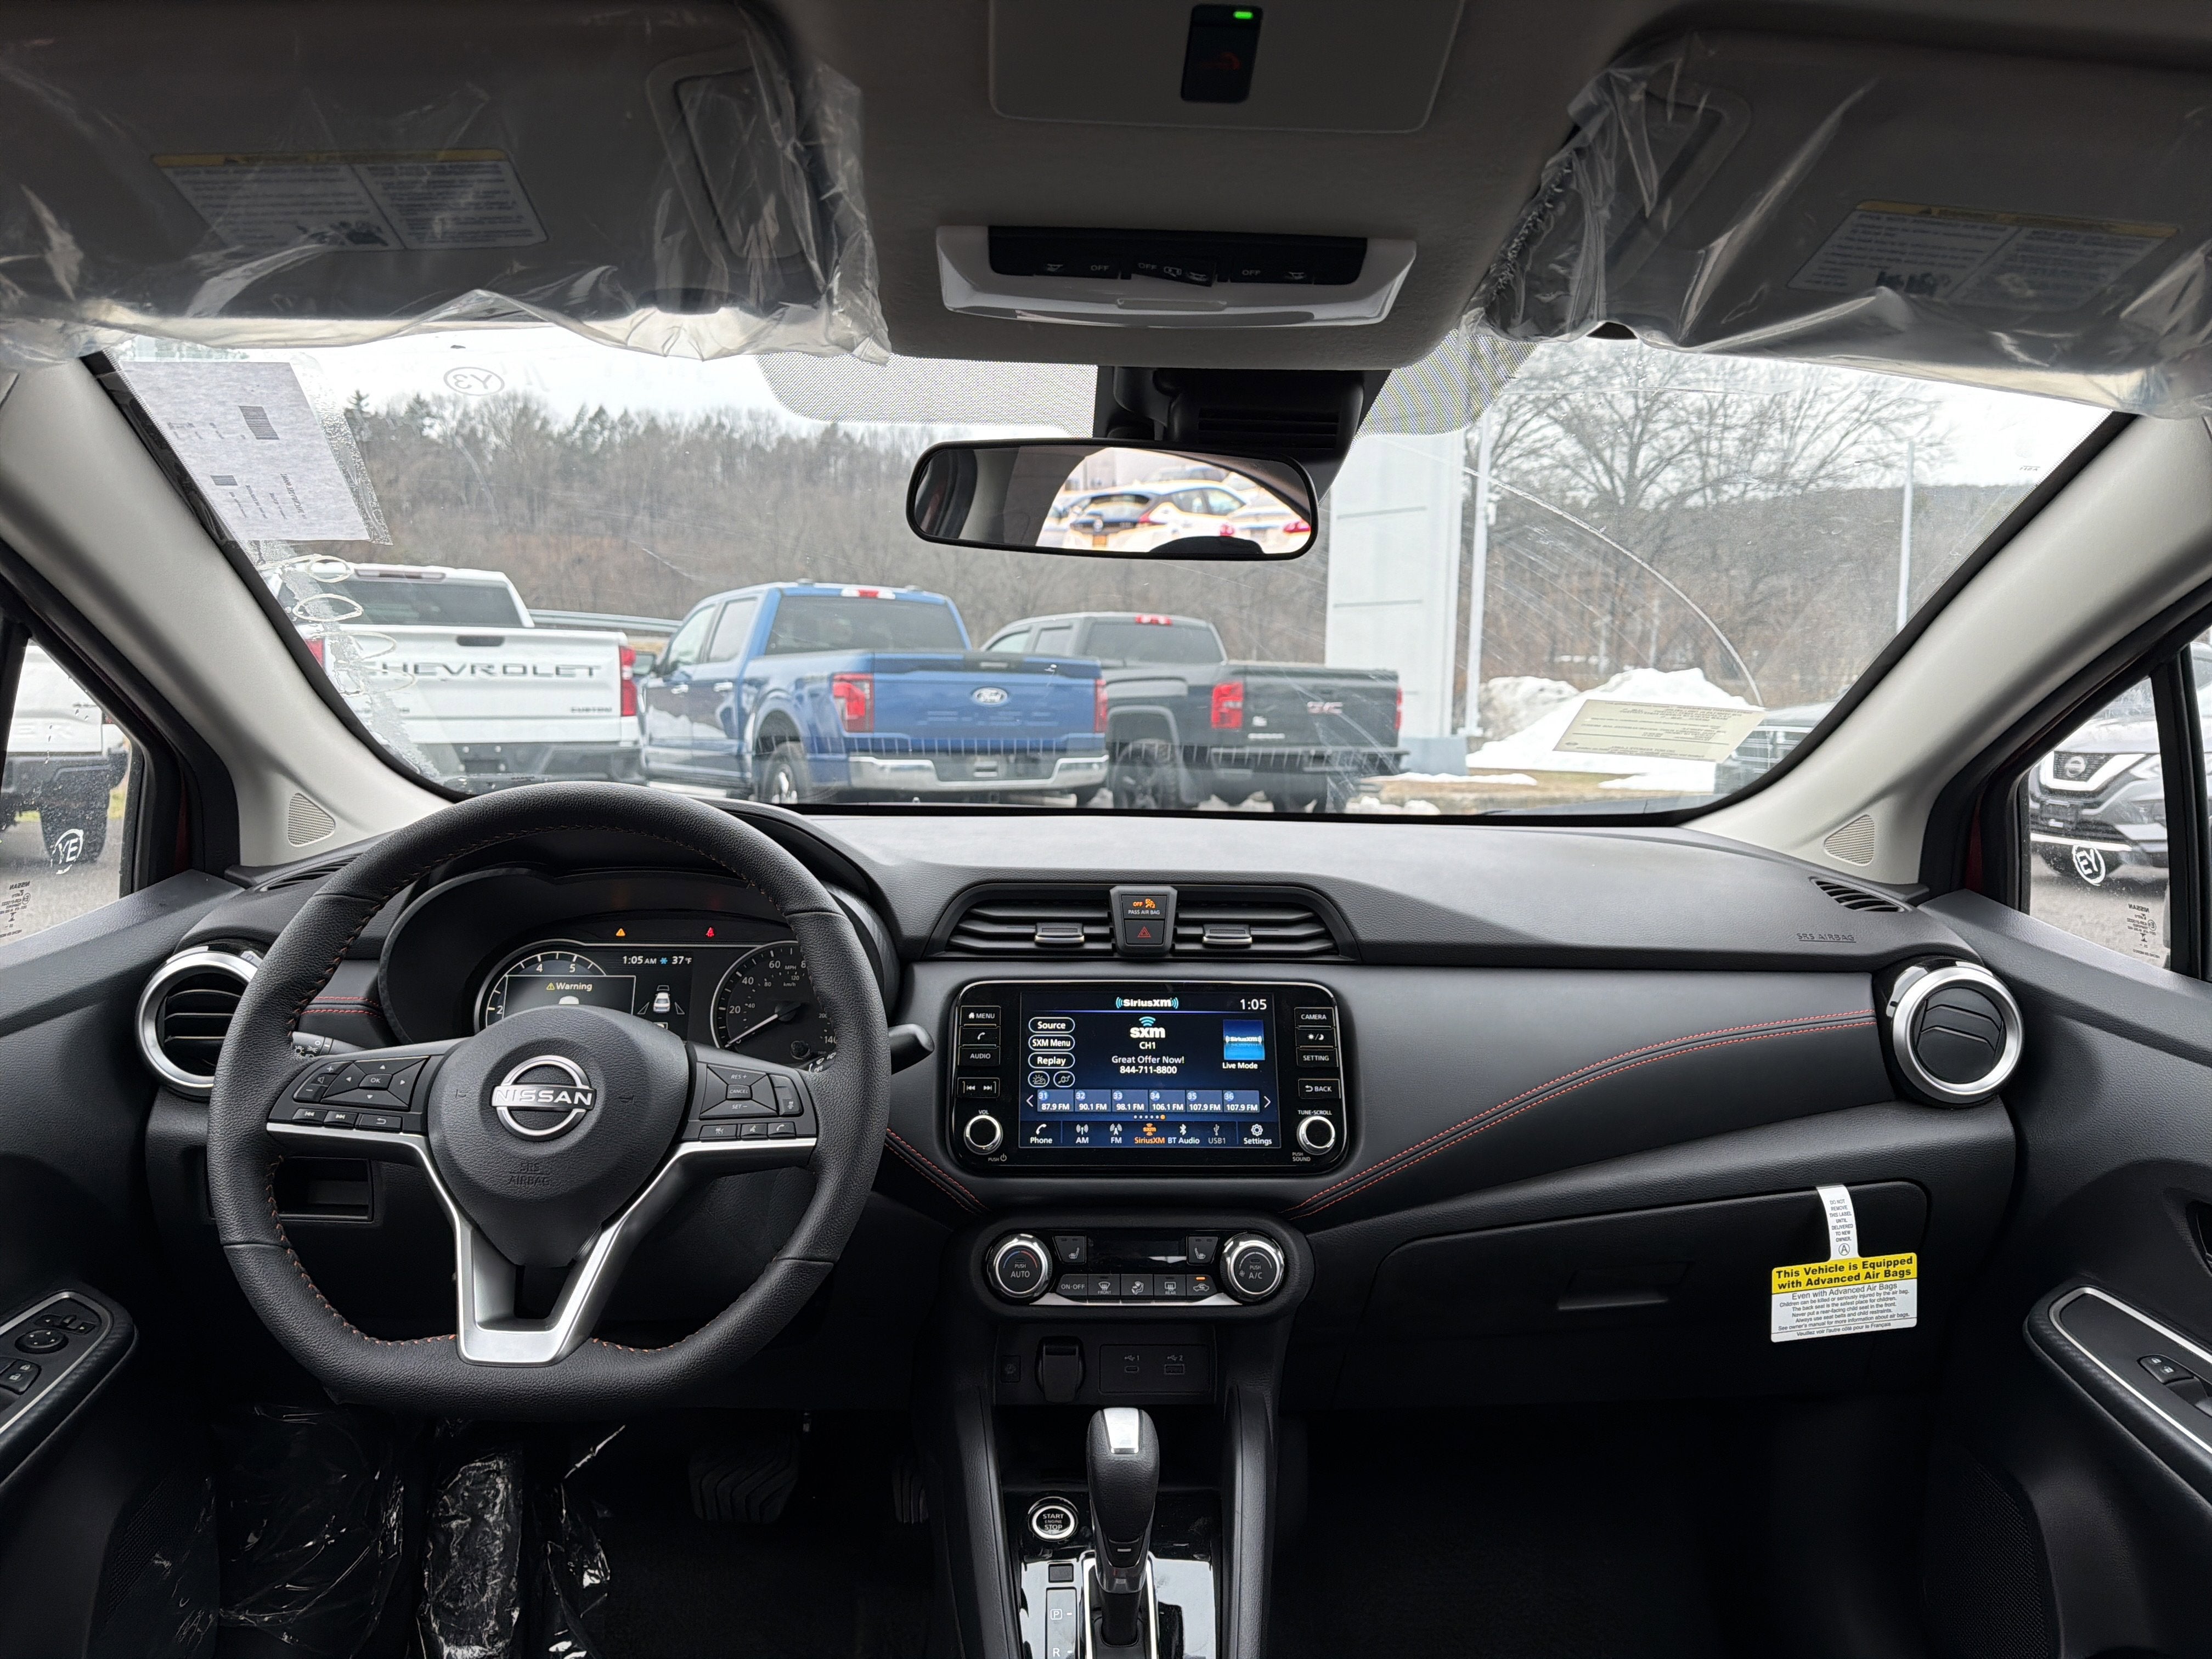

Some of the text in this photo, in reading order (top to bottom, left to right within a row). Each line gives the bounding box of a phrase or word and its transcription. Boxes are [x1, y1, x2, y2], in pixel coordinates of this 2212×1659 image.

[623, 956, 643, 964] 1:05
[536, 964, 543, 972] 4
[569, 964, 575, 973] 5
[742, 977, 754, 985] 40
[556, 982, 592, 992] Warning
[1240, 999, 1267, 1010] 1:05
[1037, 1022, 1066, 1030] Source
[1037, 1056, 1066, 1066] Replay
[1120, 1066, 1177, 1074] 844-711-8800
[495, 1089, 592, 1105] NISSAN
[1243, 1137, 1272, 1146] Settings
[1776, 1256, 1913, 1279] This Vehicle is Equipped
[1778, 1269, 1911, 1289] with Advanced Air Bags
[1829, 1285, 1865, 1296] Advanced
[1053, 1647, 1060, 1657] R
